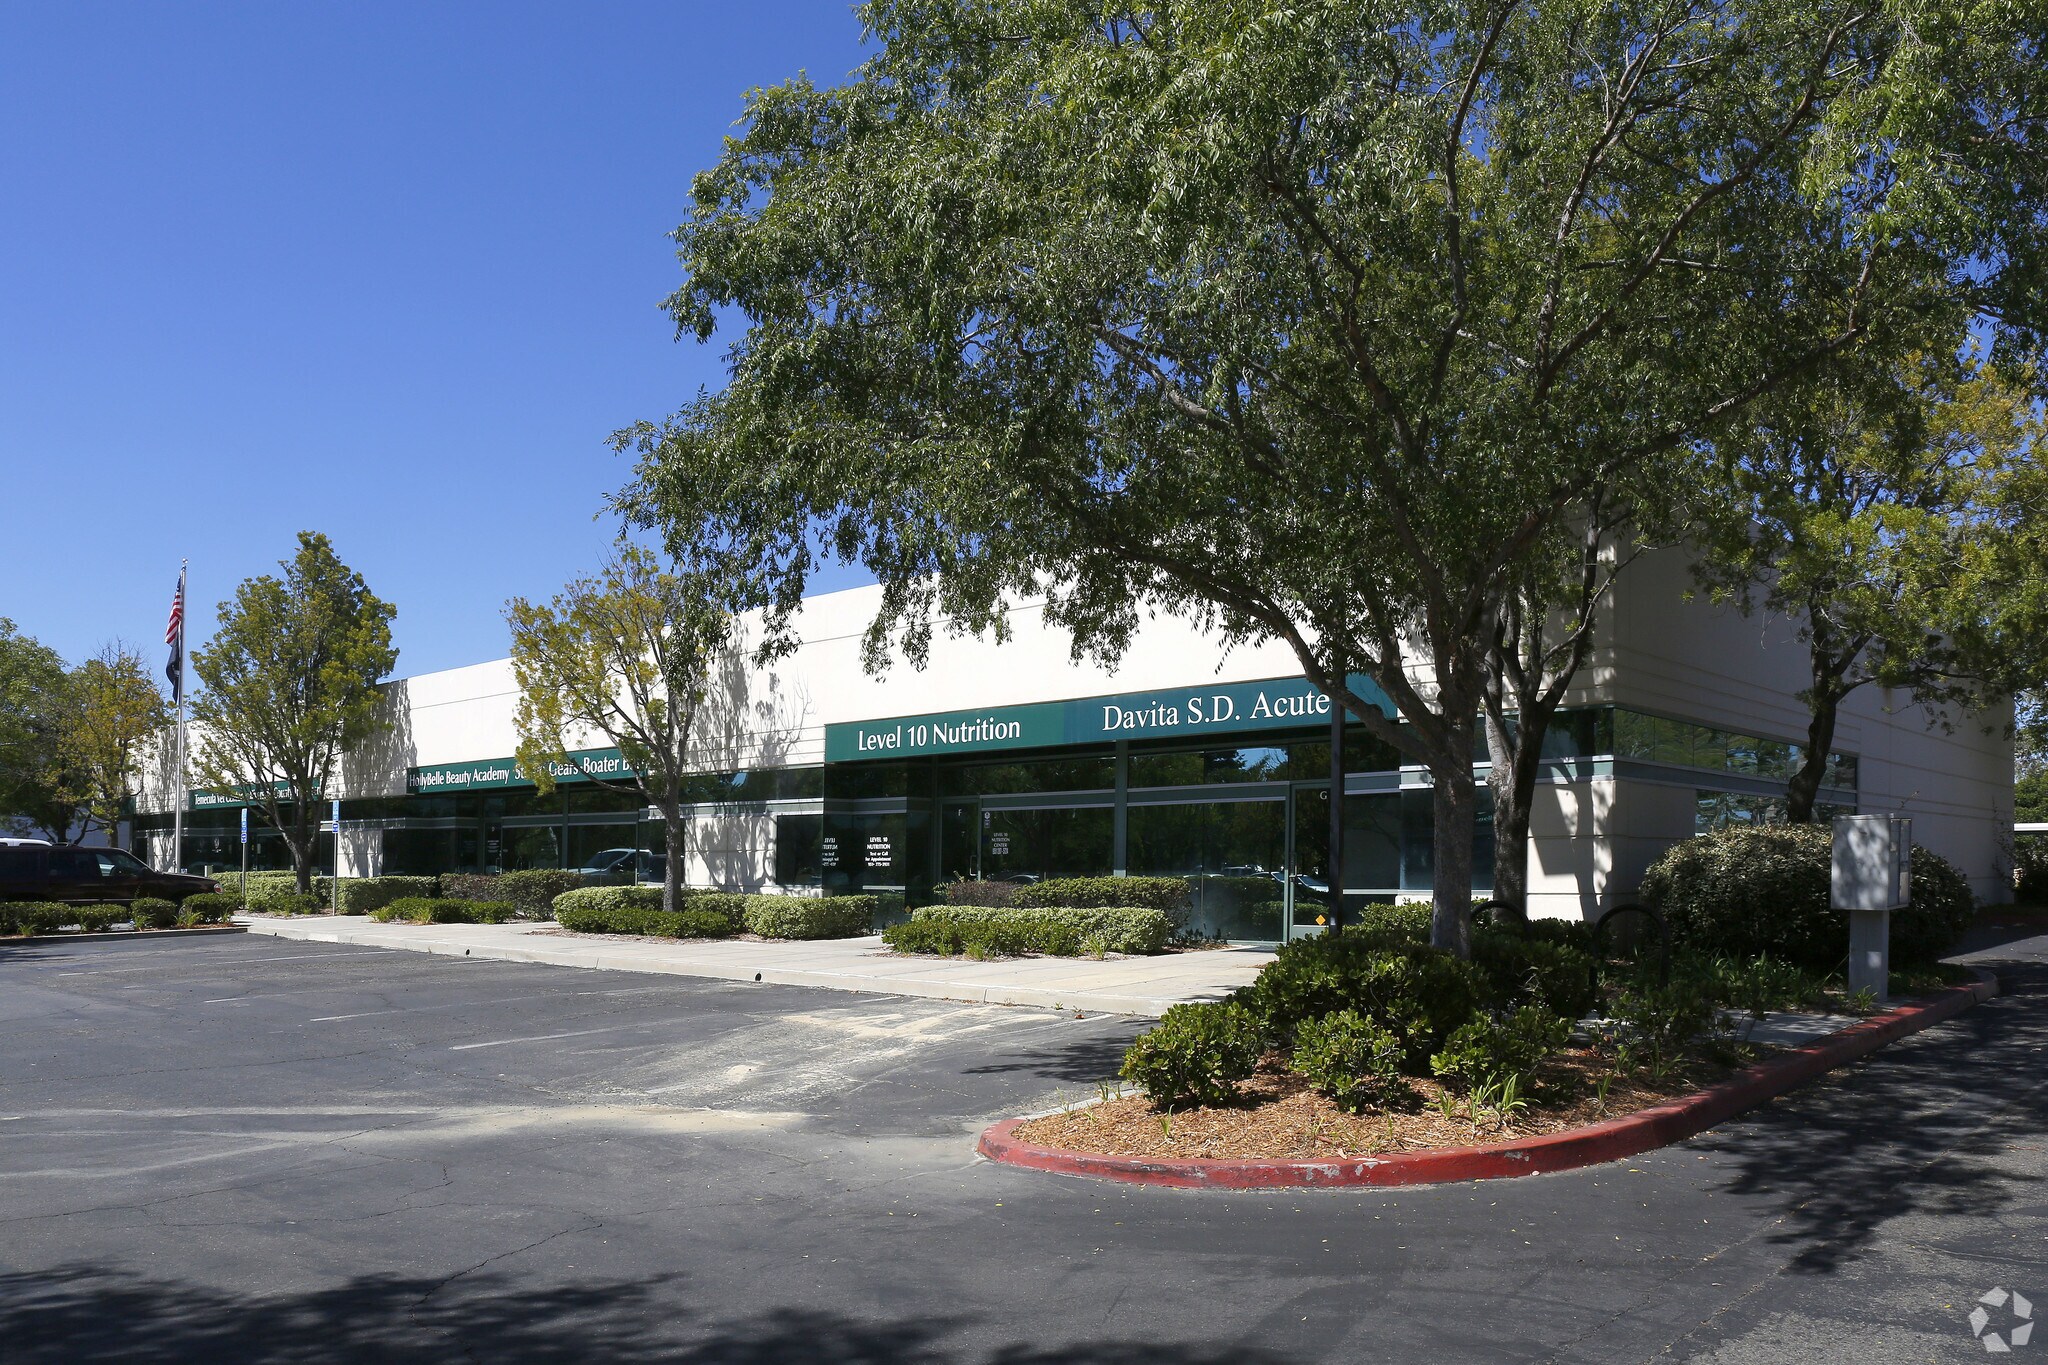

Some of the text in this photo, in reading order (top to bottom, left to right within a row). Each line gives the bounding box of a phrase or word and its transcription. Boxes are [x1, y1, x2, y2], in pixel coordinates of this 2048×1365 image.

[1102, 689, 1331, 731] Davita S.D. Acute
[858, 716, 1021, 751] Level 10 Nutrition
[409, 770, 445, 790] HollyBelle
[445, 769, 472, 787] Beauty
[472, 765, 510, 784] Academy
[194, 793, 217, 805] Temecula
[1319, 790, 1328, 800] G
